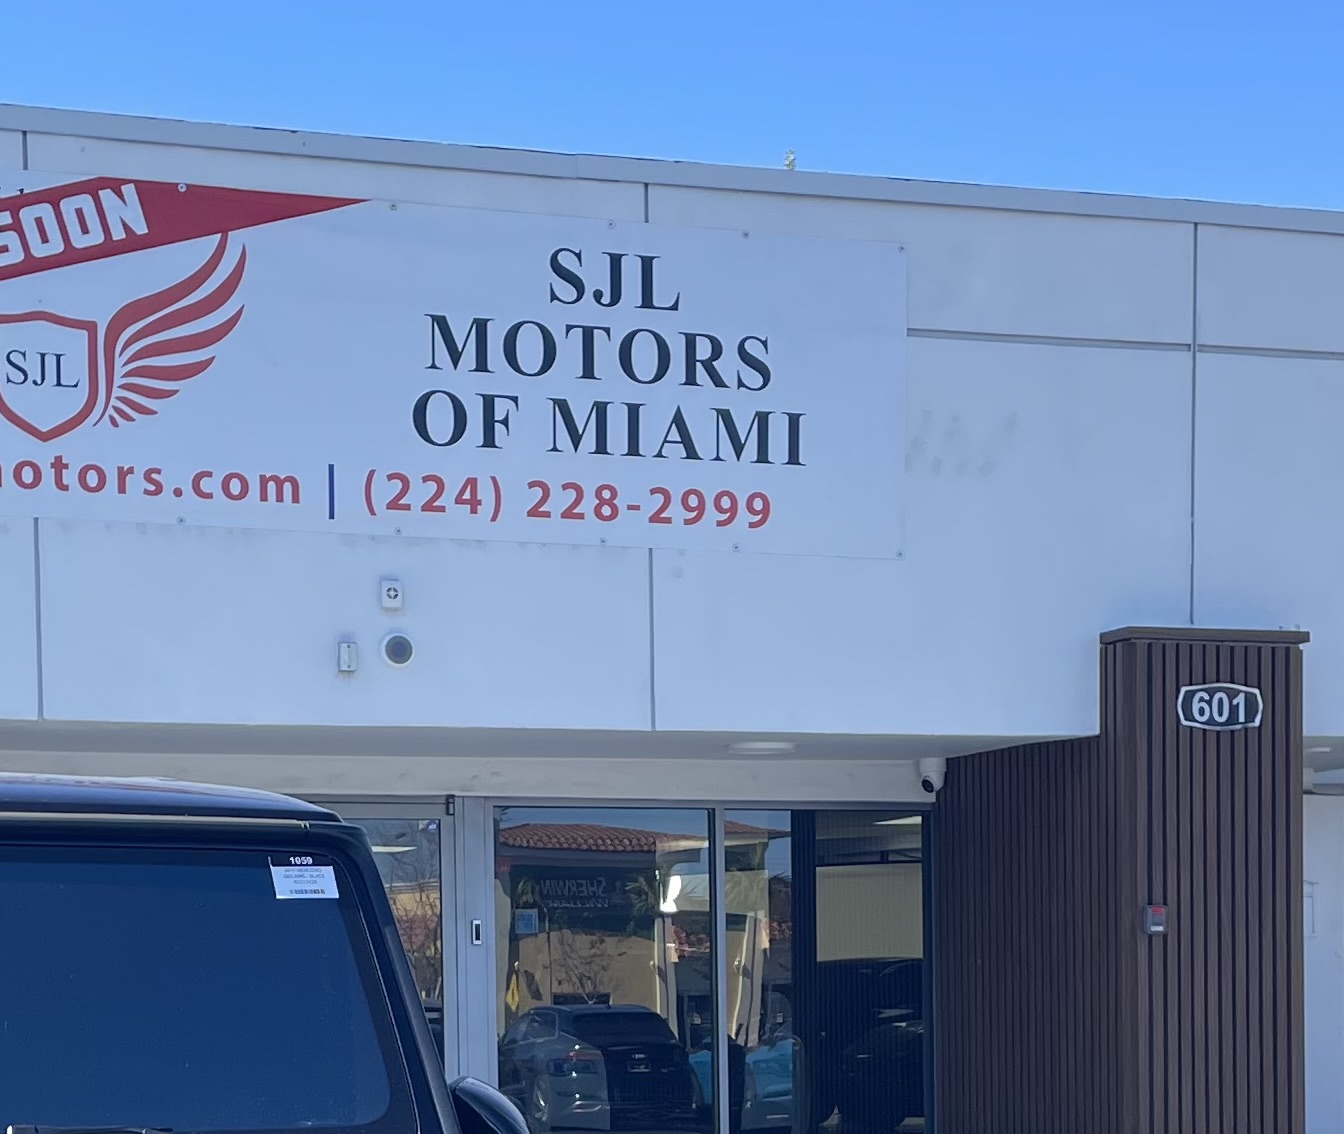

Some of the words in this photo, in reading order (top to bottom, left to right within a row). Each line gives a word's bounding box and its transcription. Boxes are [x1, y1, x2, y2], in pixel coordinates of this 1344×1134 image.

[549, 247, 681, 312] SJL
[4, 349, 80, 390] SJL
[423, 313, 772, 392] MOTORS
[412, 389, 520, 449] OF
[545, 396, 807, 467] MIAMI
[363, 468, 503, 523] (224)
[526, 479, 772, 530] 228-2999
[1191, 690, 1246, 723] 601
